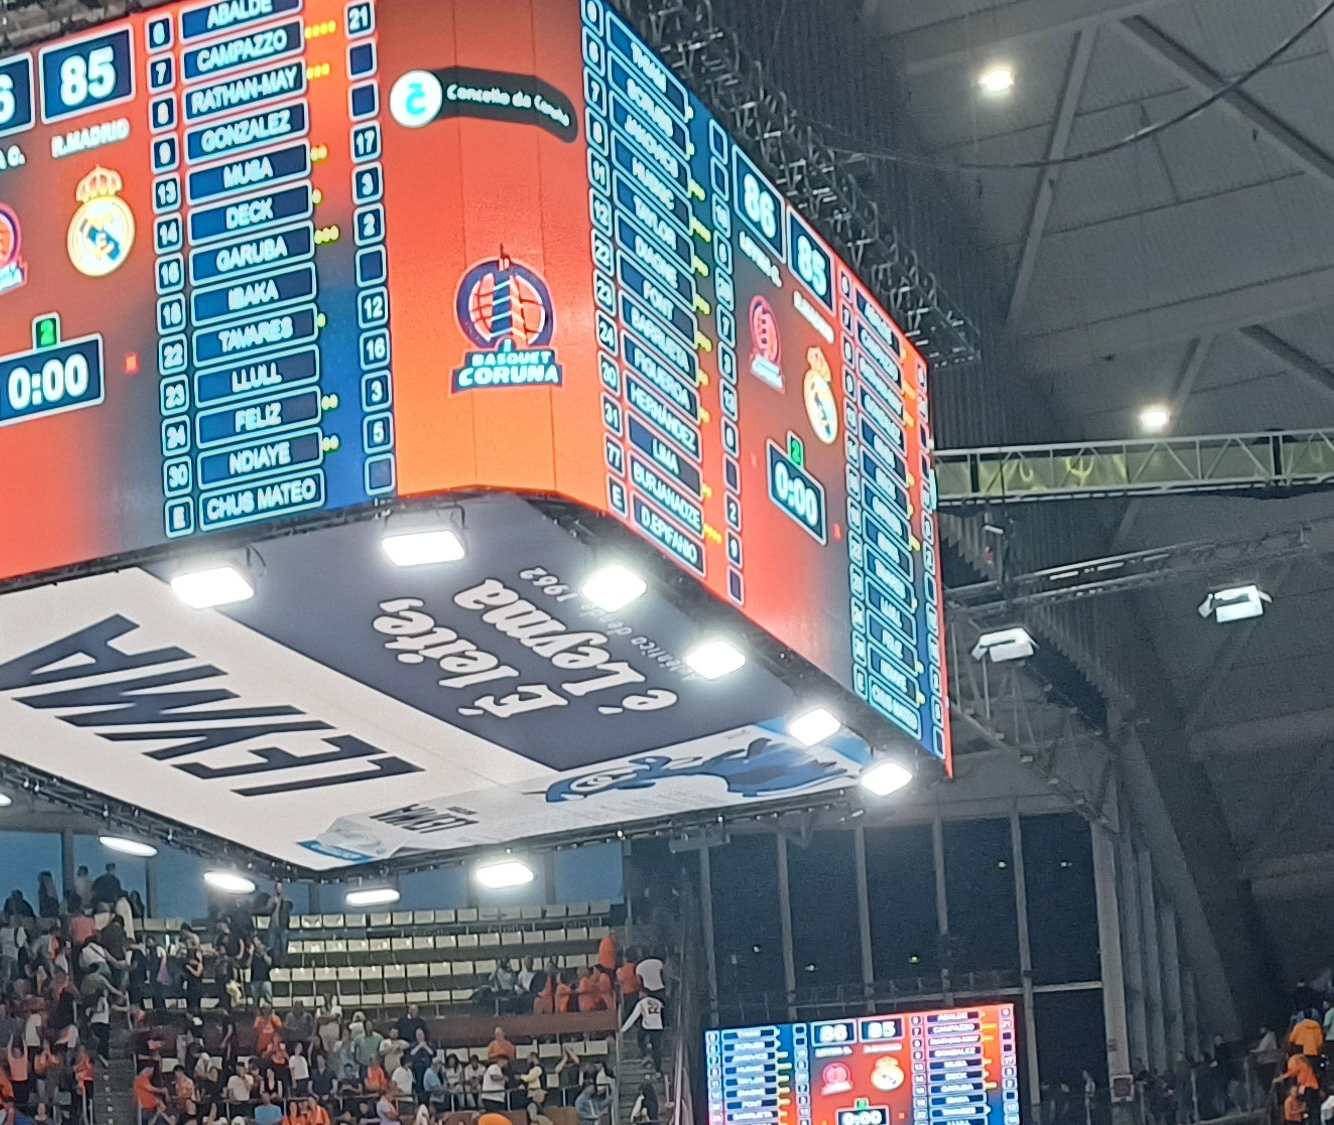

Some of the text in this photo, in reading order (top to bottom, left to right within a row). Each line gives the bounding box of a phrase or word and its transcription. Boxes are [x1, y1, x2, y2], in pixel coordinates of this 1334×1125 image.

[60, 46, 116, 106] 85
[155, 6, 369, 84] 7 CAMPAZZO 21
[191, 67, 298, 114] RATHAN-MAY
[591, 81, 599, 103] 7
[51, 118, 130, 158] R.MADRID
[201, 109, 291, 152] GONZALEZ
[158, 130, 376, 205] 13 MUSA 17
[160, 173, 374, 245] 14 DECK 3
[744, 173, 775, 240] 86
[160, 214, 376, 285] 16 GARUBA 2
[798, 236, 825, 296] 85
[228, 279, 279, 310] IBAKA
[39, 319, 55, 345] 2
[164, 296, 383, 367] 22 TAVARES 12
[472, 350, 552, 366] BASQUET
[8, 353, 89, 411] 0:00
[166, 338, 385, 408] 23 LLULL 16
[599, 321, 690, 411] 24 FIGUEROA
[602, 361, 616, 386] 30
[167, 381, 383, 449] 24 FELIZ 3
[604, 402, 680, 475] 31 LIMA
[169, 422, 384, 488] 30 NDIAYE 5
[608, 442, 737, 530] 77 BURJANADZE 2
[207, 493, 255, 521] CHUS
[257, 478, 316, 510] MATEO
[612, 485, 622, 509] E
[640, 505, 697, 563] D.EPIFANIO
[775, 470, 817, 525] 0:00
[454, 578, 645, 696] Leyma
